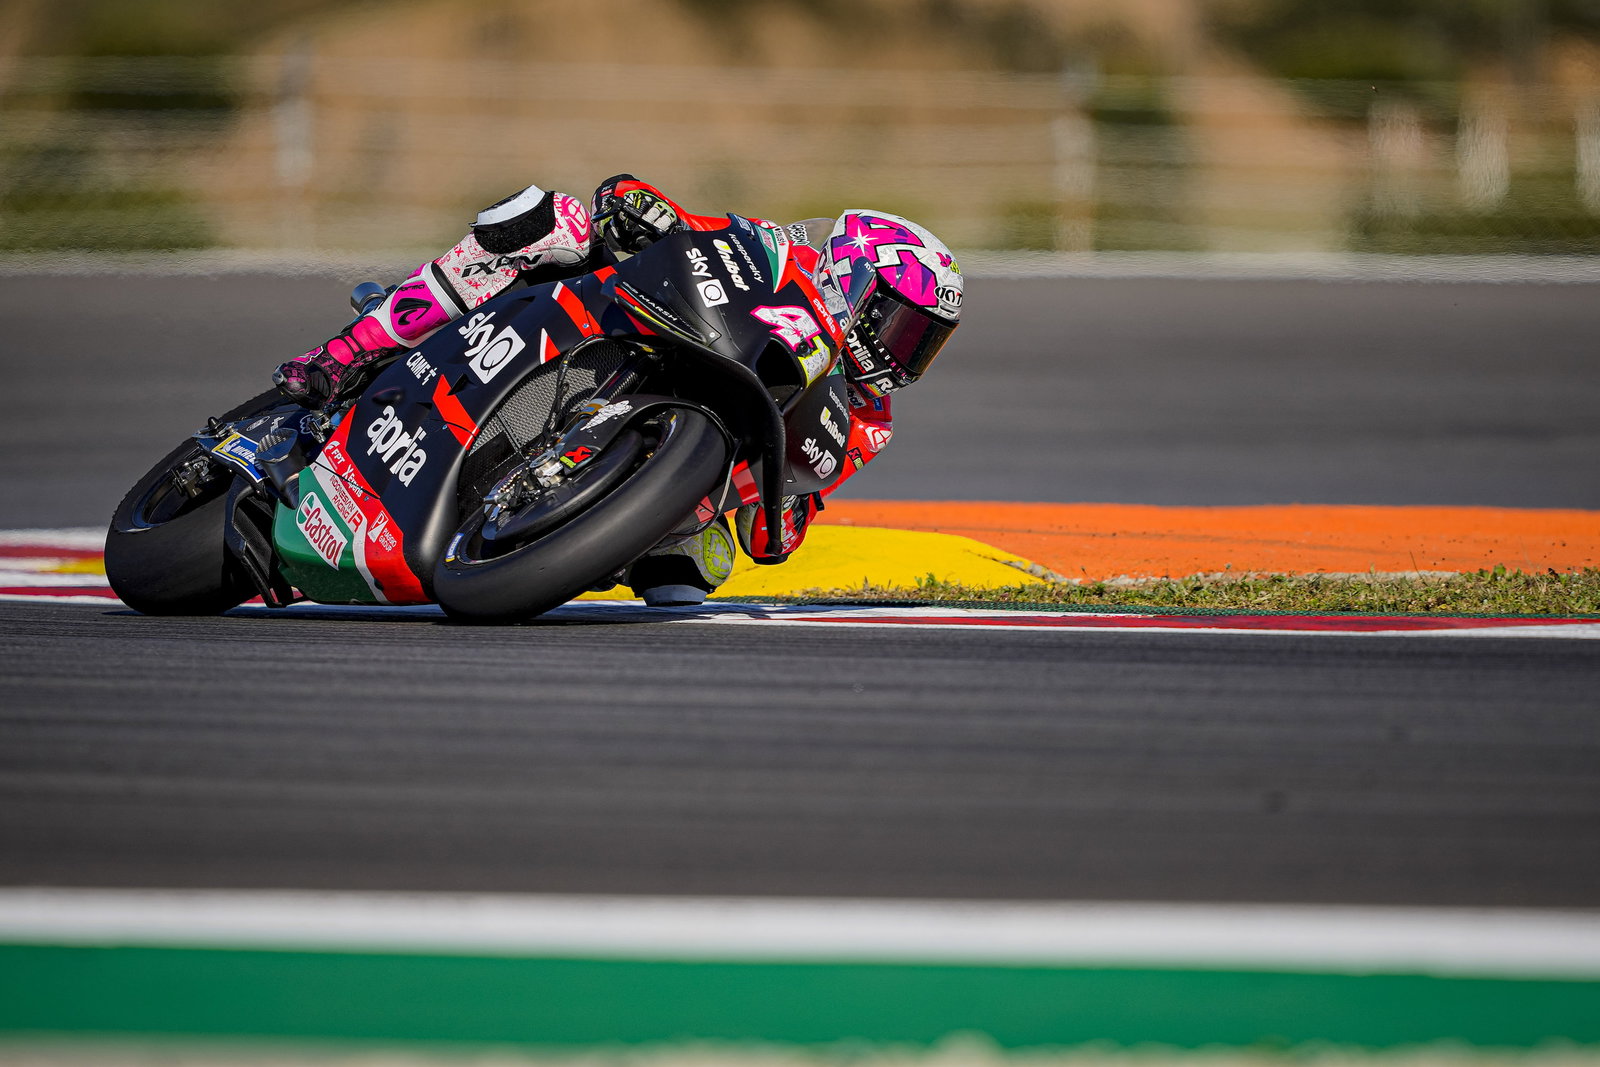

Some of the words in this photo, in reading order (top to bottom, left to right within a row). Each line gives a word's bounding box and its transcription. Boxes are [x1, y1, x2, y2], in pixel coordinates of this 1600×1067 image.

[685, 247, 712, 278] sky
[639, 294, 678, 322] MARSH
[812, 298, 837, 334] aprilia
[458, 311, 496, 358] sky
[406, 351, 425, 380] CAME
[819, 406, 845, 448] Unibat
[330, 449, 345, 465] FPT
[366, 405, 427, 488] aprilia
[801, 437, 823, 464] sky
[331, 494, 350, 519] RACING
[304, 507, 344, 567] Castrol
[378, 536, 393, 552] GROUP
